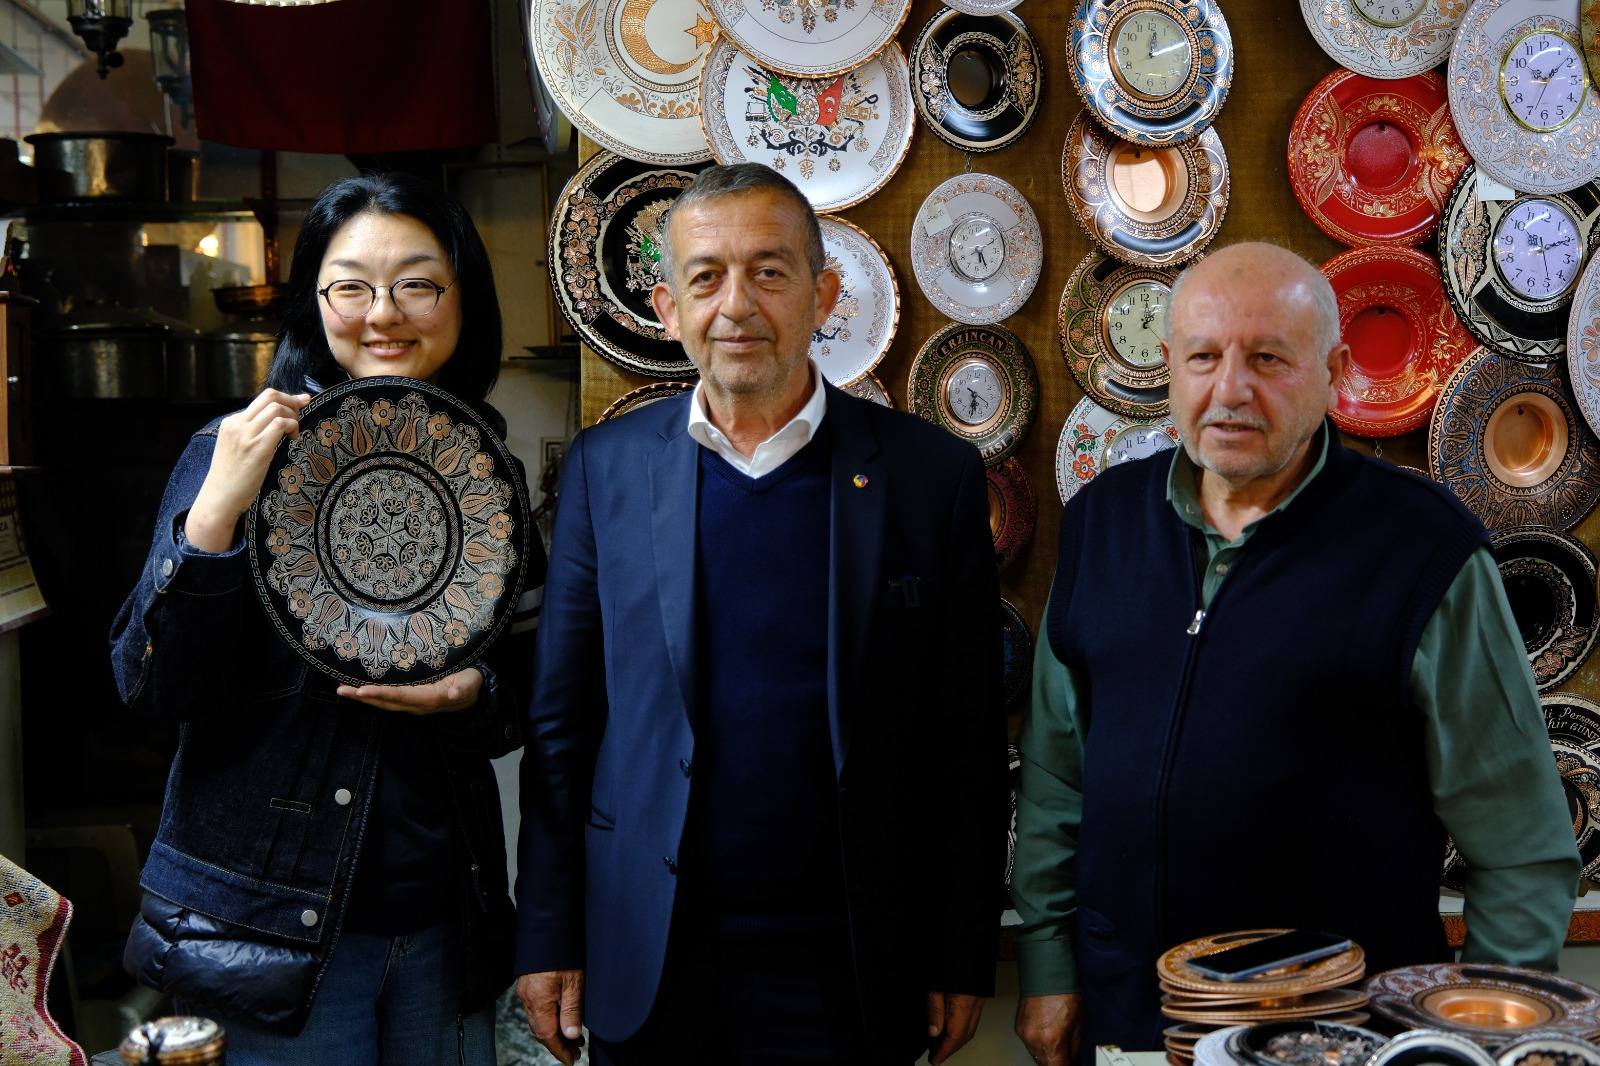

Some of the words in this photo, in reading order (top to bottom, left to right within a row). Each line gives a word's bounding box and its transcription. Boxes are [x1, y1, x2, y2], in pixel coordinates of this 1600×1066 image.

[1378, 6, 1384, 14] 7
[1392, 7, 1399, 15] 6
[1137, 24, 1143, 32] 11
[1148, 22, 1156, 31] 12
[1127, 33, 1137, 41] 10
[1526, 46, 1533, 55] 11
[1540, 41, 1549, 51] 12
[1122, 47, 1129, 55] 9
[1515, 58, 1527, 68] 10
[1567, 58, 1574, 67] 2
[1160, 77, 1166, 85] 5
[1510, 76, 1518, 86] 9
[1571, 75, 1578, 85] 3
[1515, 93, 1523, 103] 8
[1567, 92, 1574, 102] 4
[1527, 106, 1533, 115] 7
[1540, 110, 1548, 120] 6
[1556, 106, 1564, 115] 5
[1527, 212, 1534, 220] 11
[1514, 220, 1525, 231] 10
[1505, 236, 1513, 245] 9
[1563, 236, 1570, 246] 2
[1506, 253, 1514, 263] 8
[1563, 254, 1570, 264] 3
[1516, 268, 1522, 278] 7
[1556, 270, 1563, 278] 4
[1527, 277, 1535, 287] 6
[1543, 278, 1551, 287] 5
[1115, 322, 1122, 330] 9
[940, 330, 1004, 354] ERZİNCAN
[1120, 336, 1126, 344] 8
[1142, 349, 1148, 358] 6
[1126, 440, 1132, 448] 11
[1137, 436, 1146, 444] 12
[981, 440, 1007, 458] RASI
